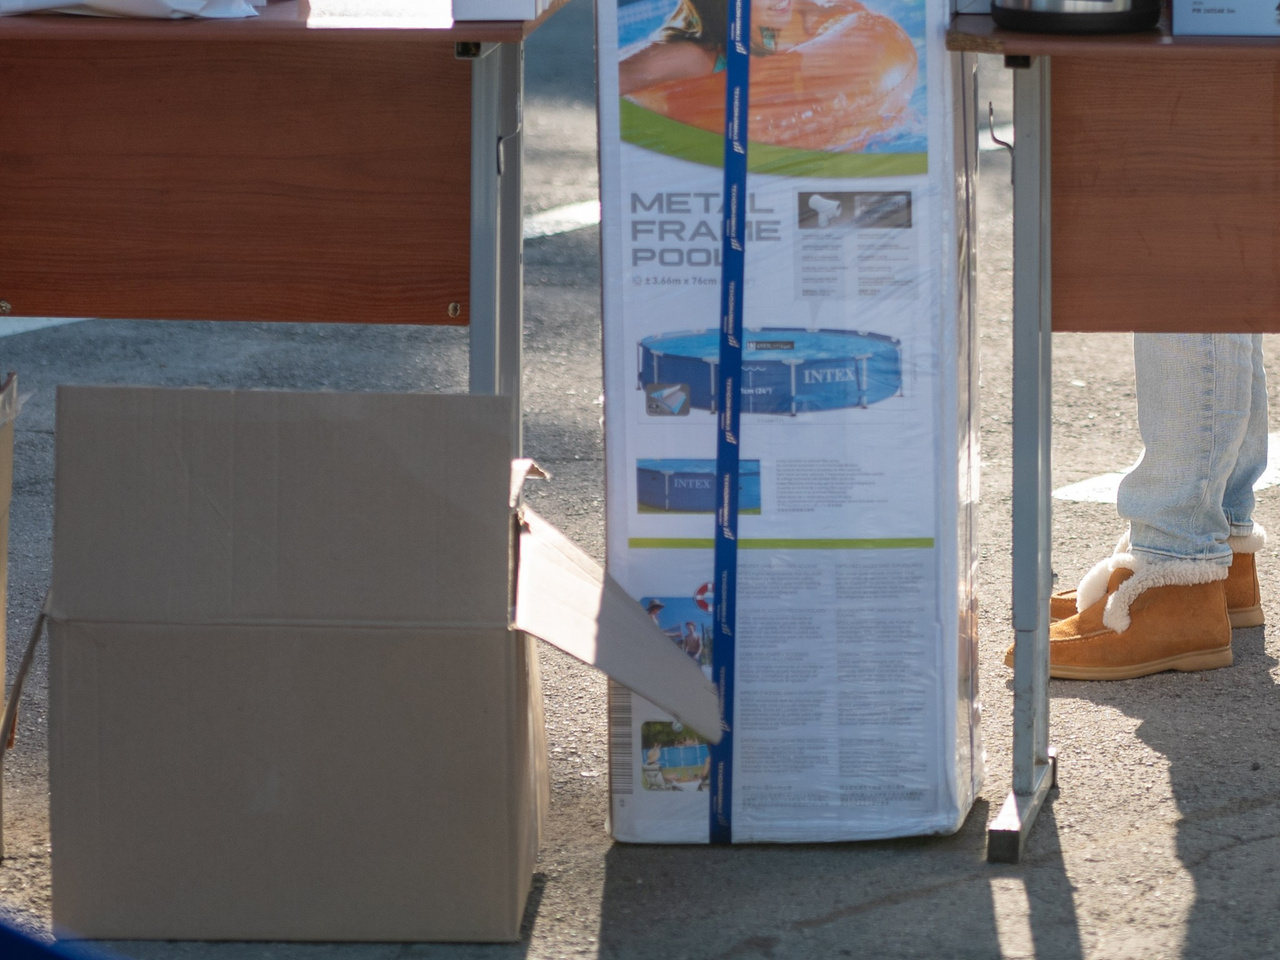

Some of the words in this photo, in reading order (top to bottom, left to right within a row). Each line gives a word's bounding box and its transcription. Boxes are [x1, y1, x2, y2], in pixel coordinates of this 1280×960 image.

[630, 193, 774, 214] METL
[691, 276, 717, 286] 76cm
[803, 368, 855, 384] INTEX
[674, 478, 710, 489] INTEX
